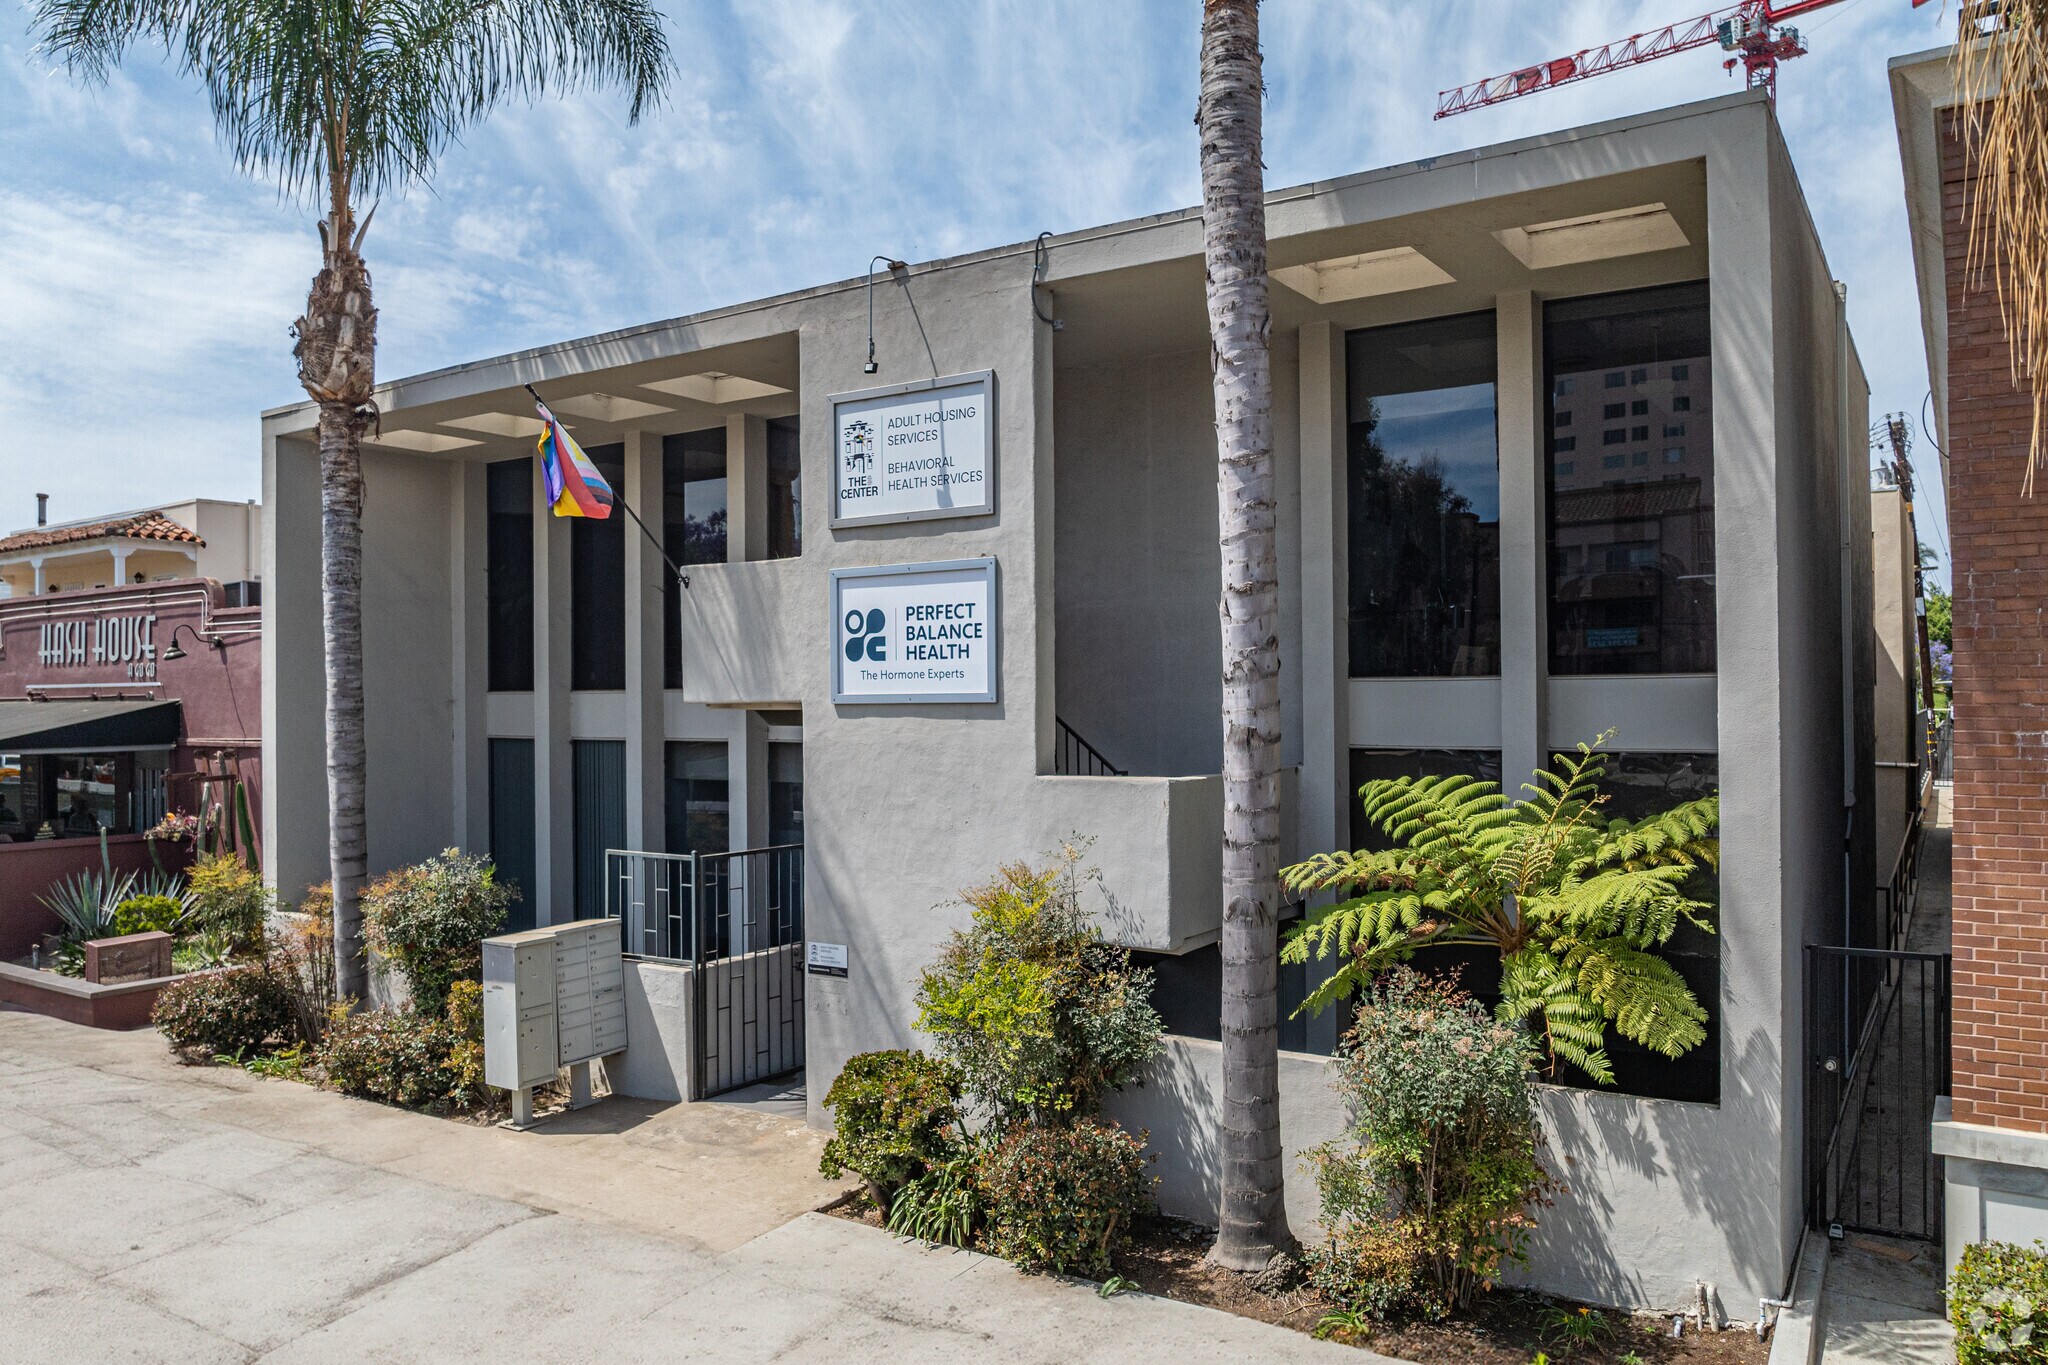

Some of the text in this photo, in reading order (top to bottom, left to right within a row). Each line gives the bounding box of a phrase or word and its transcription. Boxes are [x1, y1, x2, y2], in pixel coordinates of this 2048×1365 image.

[887, 406, 976, 429] ADULT HOUSING
[887, 429, 938, 446] SERVICES
[888, 456, 955, 474] BEHAVIORAL
[848, 476, 867, 488] THE
[888, 476, 928, 491] HEALTH
[930, 470, 983, 487] SERVICES
[841, 486, 879, 499] CENTER
[906, 602, 976, 621] PERFECT
[38, 615, 156, 664] HASH HOUSE
[906, 622, 983, 641] BALANCE
[906, 643, 970, 661] HEALTH
[860, 668, 965, 681] The Hormone Experts
